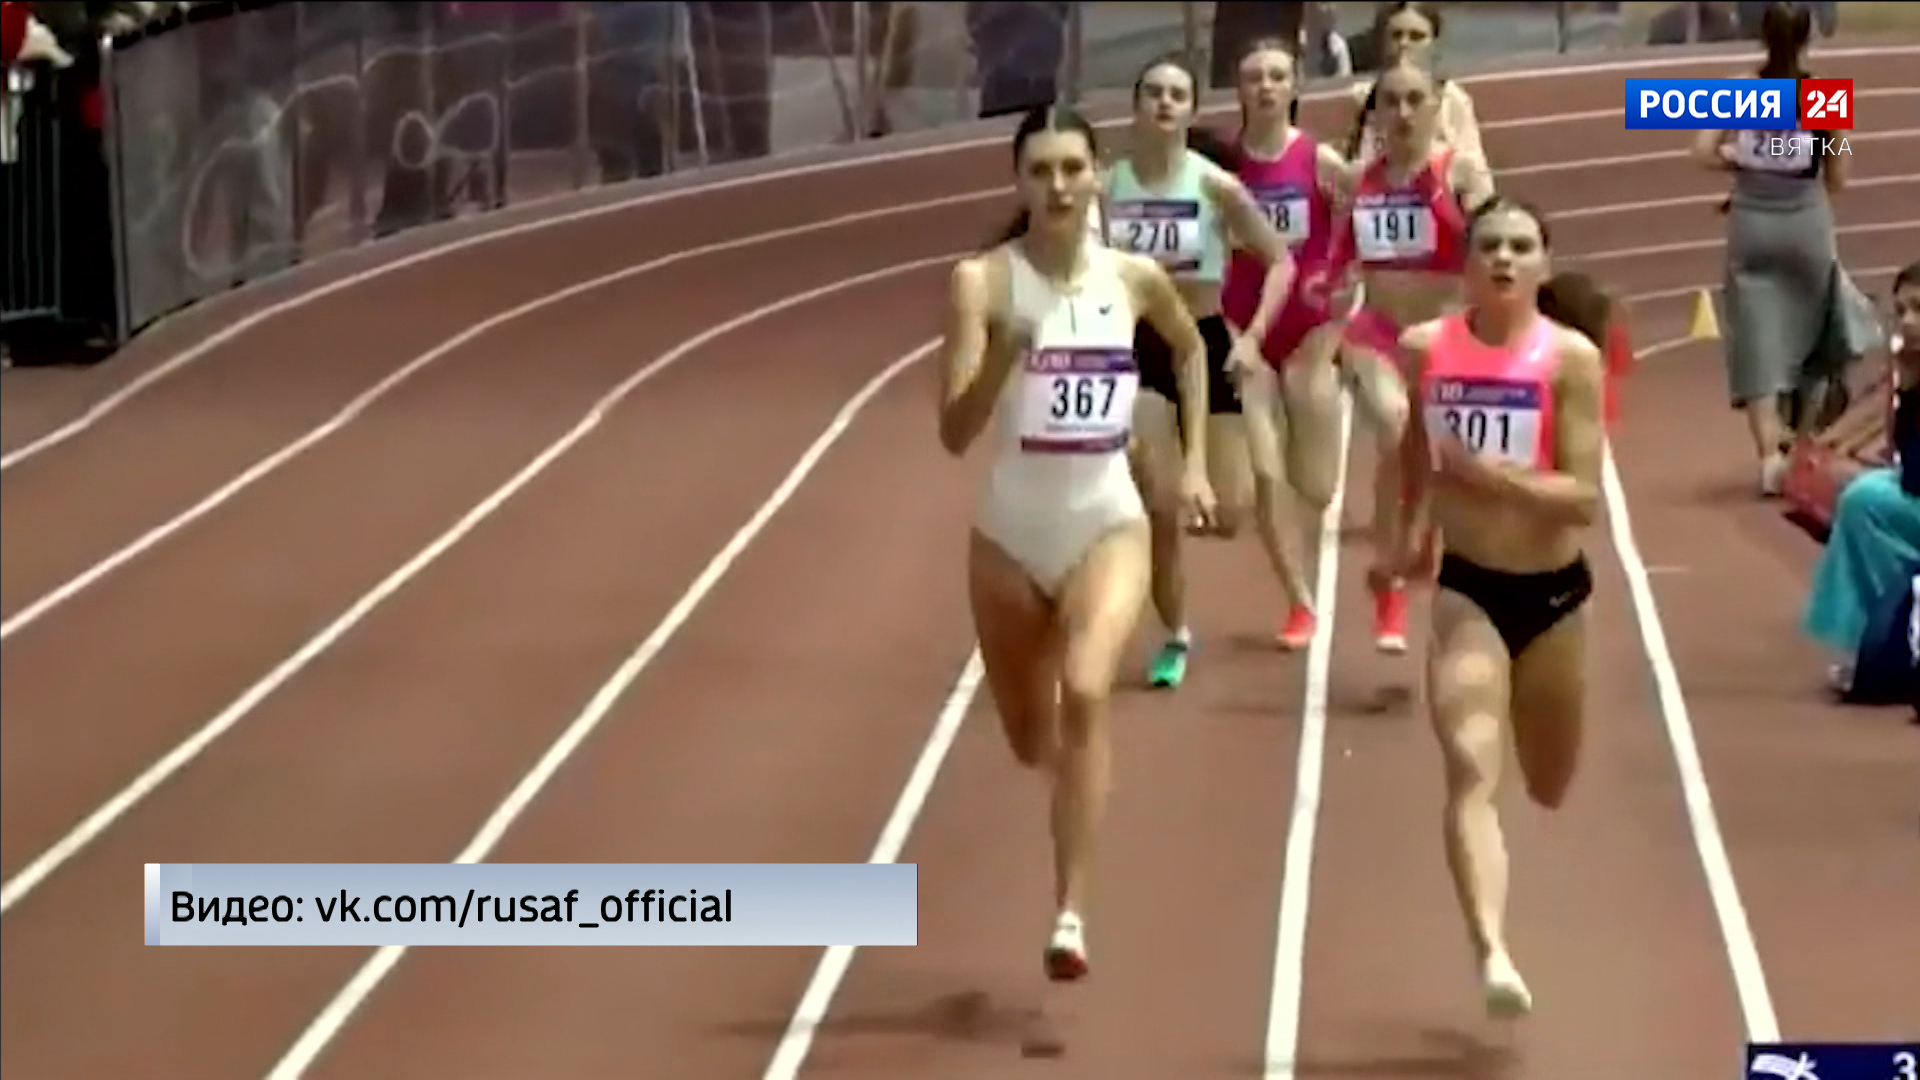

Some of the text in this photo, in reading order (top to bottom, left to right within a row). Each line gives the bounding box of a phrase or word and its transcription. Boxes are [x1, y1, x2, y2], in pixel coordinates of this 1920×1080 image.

[1128, 222, 1179, 251] 270
[1374, 211, 1414, 241] 191
[1051, 378, 1117, 419] 367
